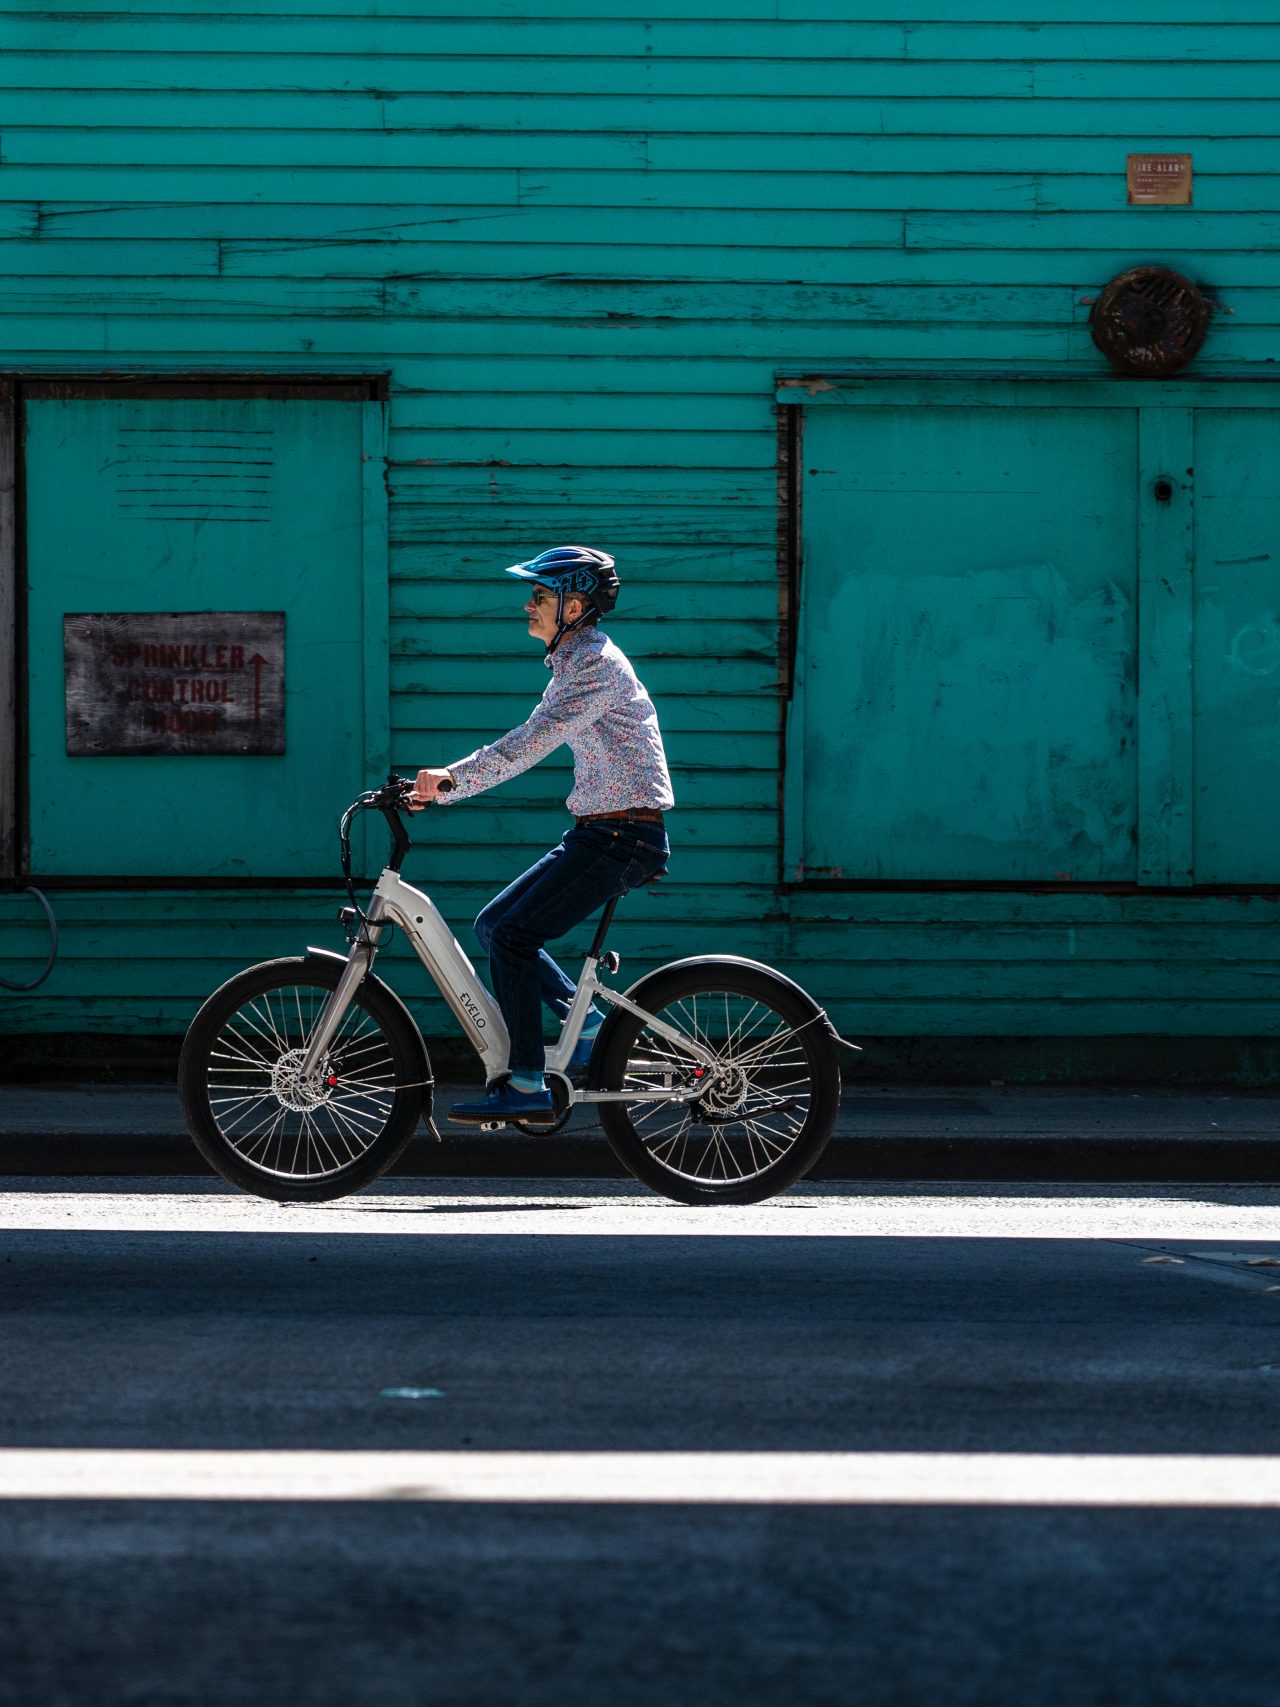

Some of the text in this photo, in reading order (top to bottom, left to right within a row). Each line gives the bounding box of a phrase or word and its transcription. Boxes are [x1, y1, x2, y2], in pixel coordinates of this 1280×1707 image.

[111, 644, 245, 669] SPRINKLER
[127, 677, 235, 703] CONTROL
[150, 709, 218, 735] ROOM
[459, 992, 486, 1029] EVELO
